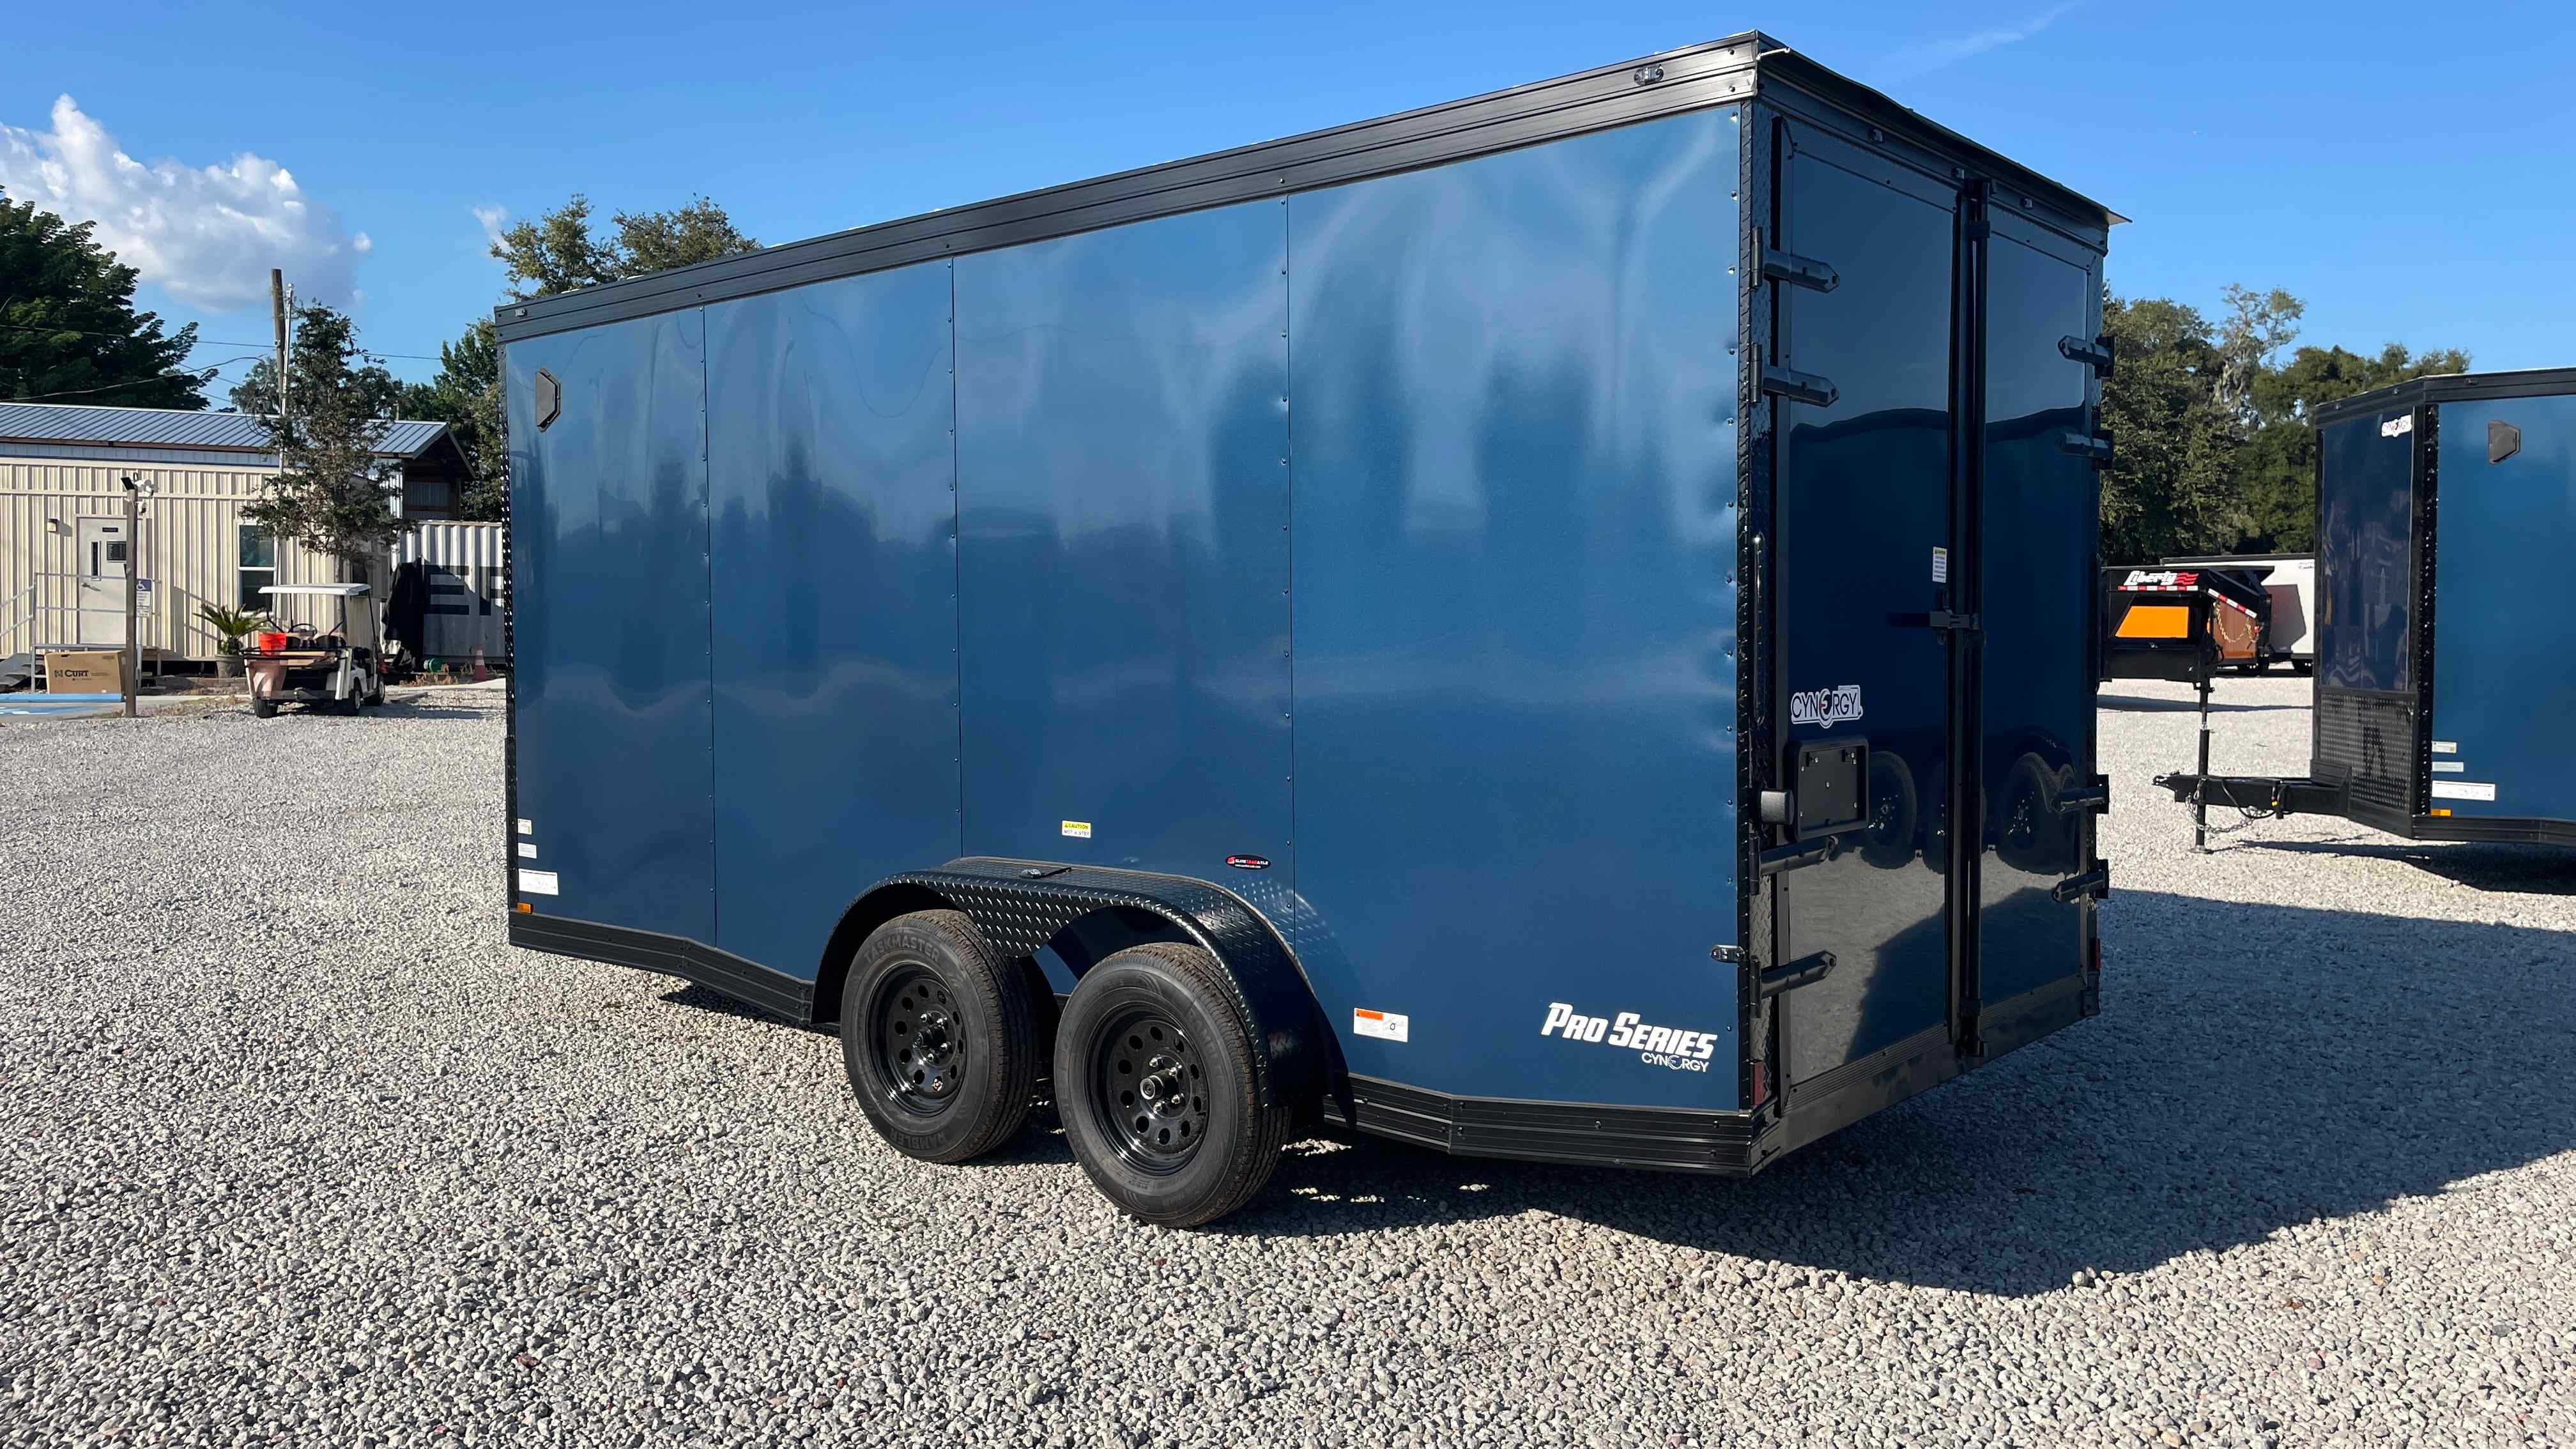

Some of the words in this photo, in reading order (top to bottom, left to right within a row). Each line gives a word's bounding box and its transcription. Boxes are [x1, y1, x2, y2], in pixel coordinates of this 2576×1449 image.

[2123, 570, 2177, 586] Liberty
[1792, 689, 1857, 721] CYNERGY
[864, 935, 941, 963] TASKMASTER
[1540, 1002, 1609, 1043] PRO
[1607, 1011, 1718, 1059] SERIES
[1641, 1052, 1709, 1073] CYNERGY
[889, 1128, 947, 1149] RAMBLER
